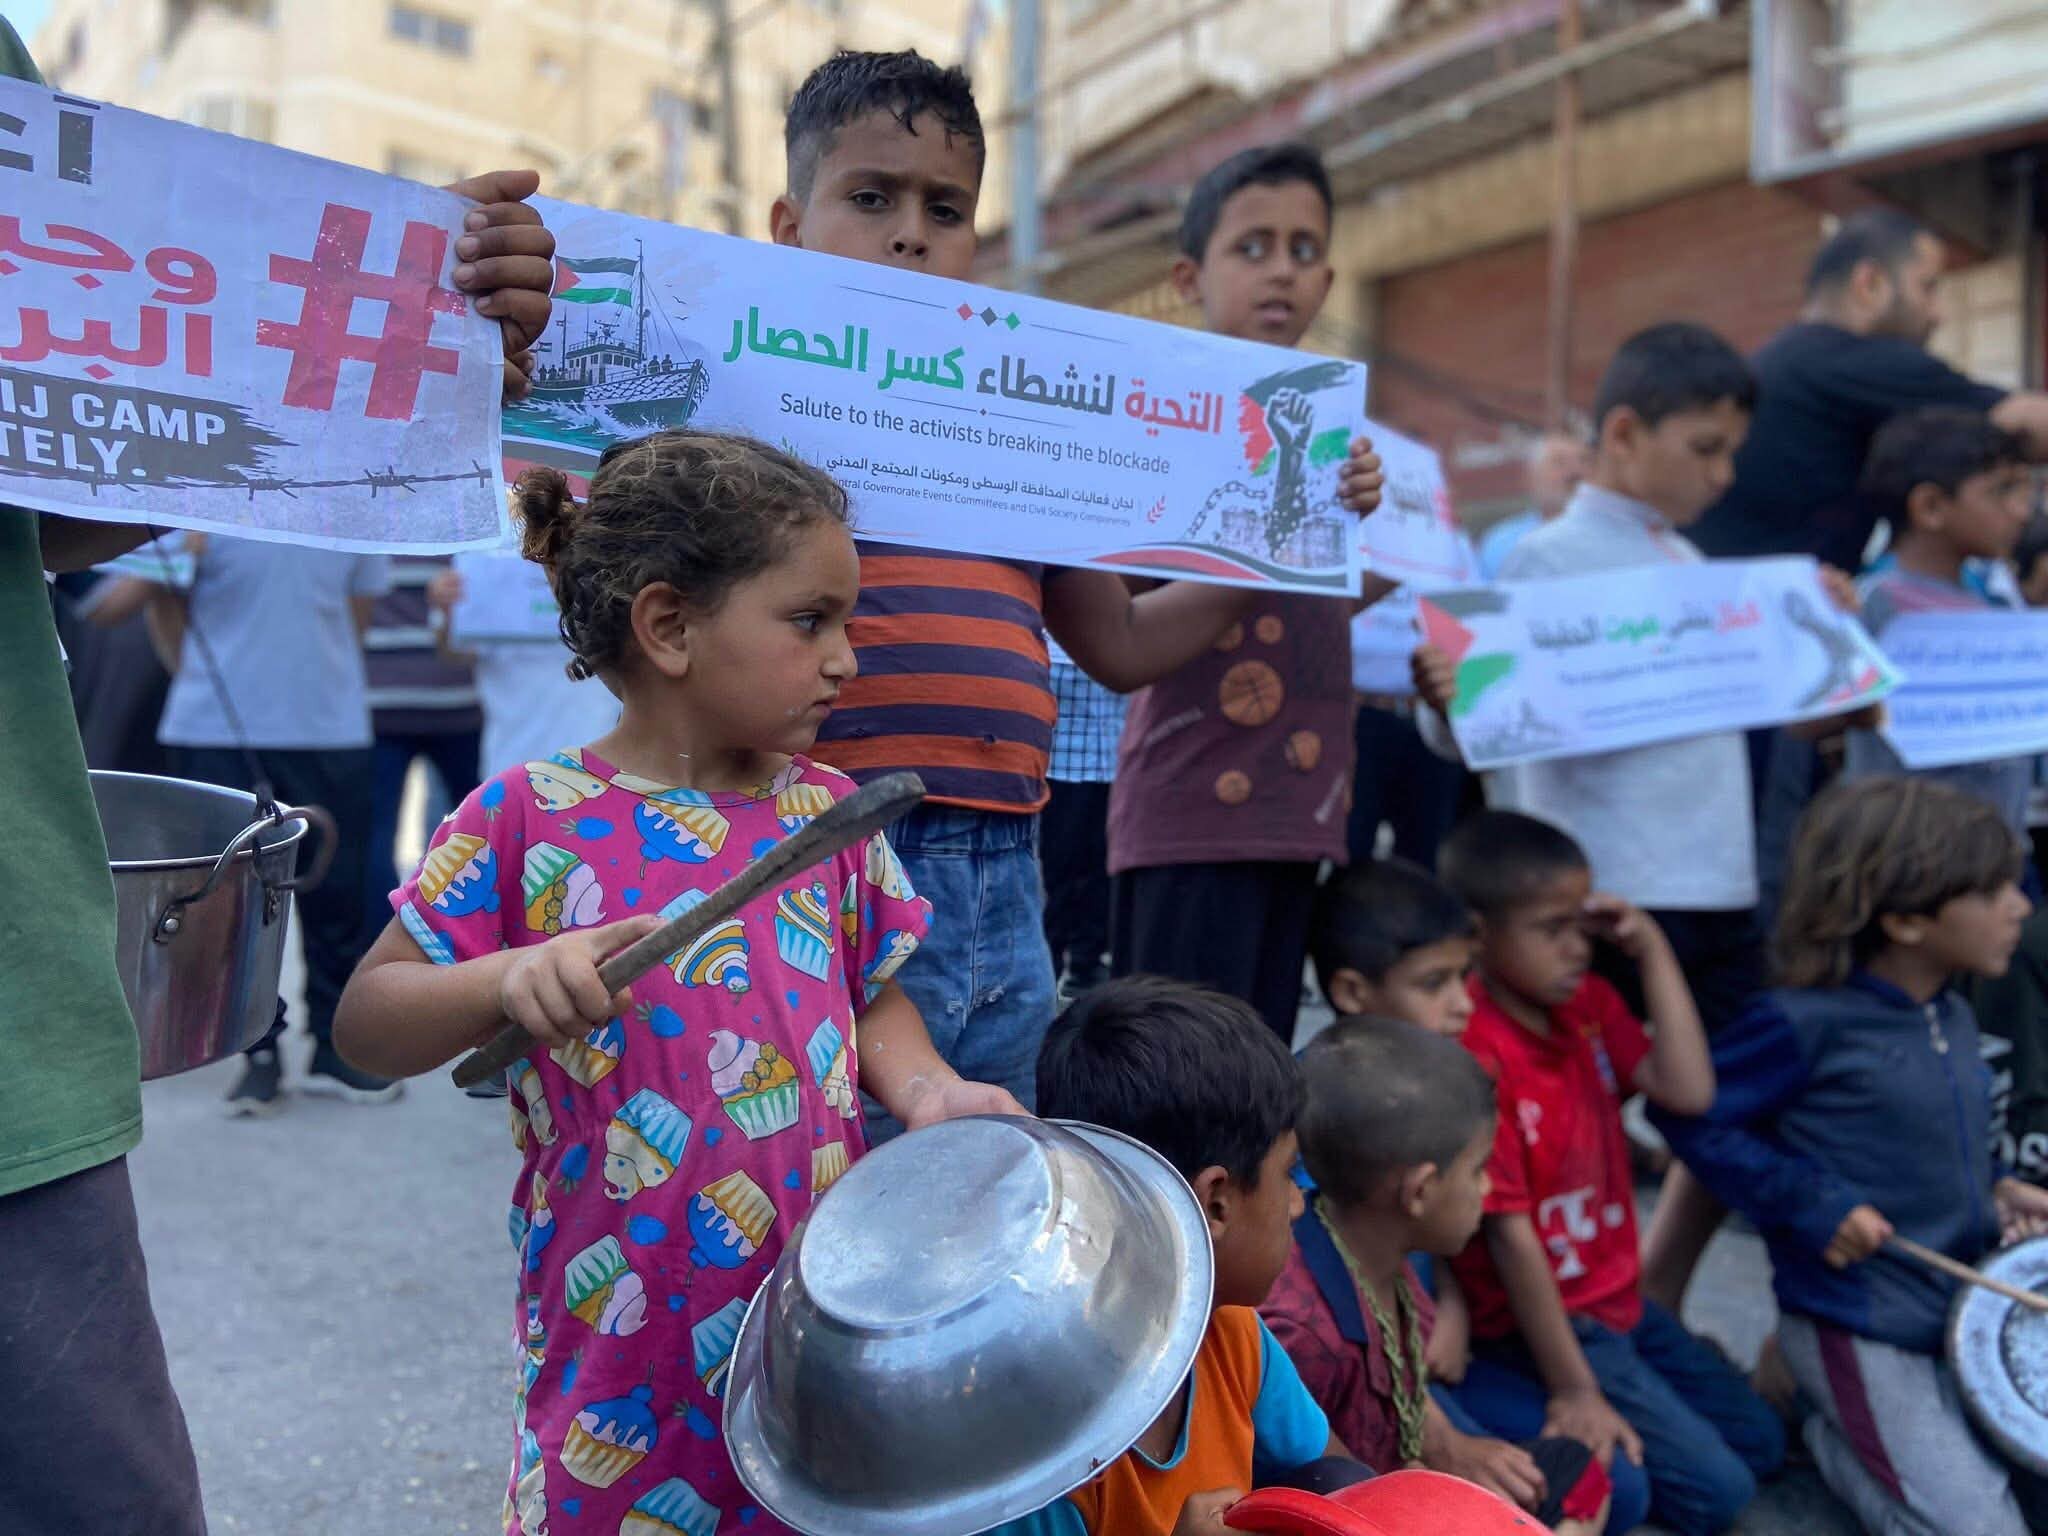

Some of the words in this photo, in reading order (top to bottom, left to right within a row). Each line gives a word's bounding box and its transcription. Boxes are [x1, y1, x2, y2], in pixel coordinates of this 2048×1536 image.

[722, 306, 869, 372] الحصار
[877, 346, 965, 390] كسر
[976, 355, 1116, 416] لنشطاء
[72, 392, 225, 446] CAMP
[1124, 378, 1224, 438] التحية
[779, 393, 843, 421] Salute
[848, 405, 868, 425] to
[873, 408, 904, 431] the
[909, 417, 983, 445] activists
[987, 427, 1062, 462] breaking
[1066, 442, 1094, 462] the
[1097, 446, 1171, 474] blockade
[826, 455, 868, 472] المدني
[870, 462, 918, 479] المجتمع
[920, 467, 969, 489] ومكونات
[833, 477, 861, 490] ntral
[862, 480, 921, 498] Governorate
[922, 488, 953, 504] Events
[954, 494, 1008, 511] Committees
[1009, 501, 1027, 514] and
[1028, 503, 1047, 516] Civil
[1048, 508, 1079, 521] Society
[972, 476, 1018, 495] الوسطى
[1020, 482, 1070, 500] المحافظة
[1072, 491, 1110, 507] فعاليات
[1111, 498, 1134, 513] لجان
